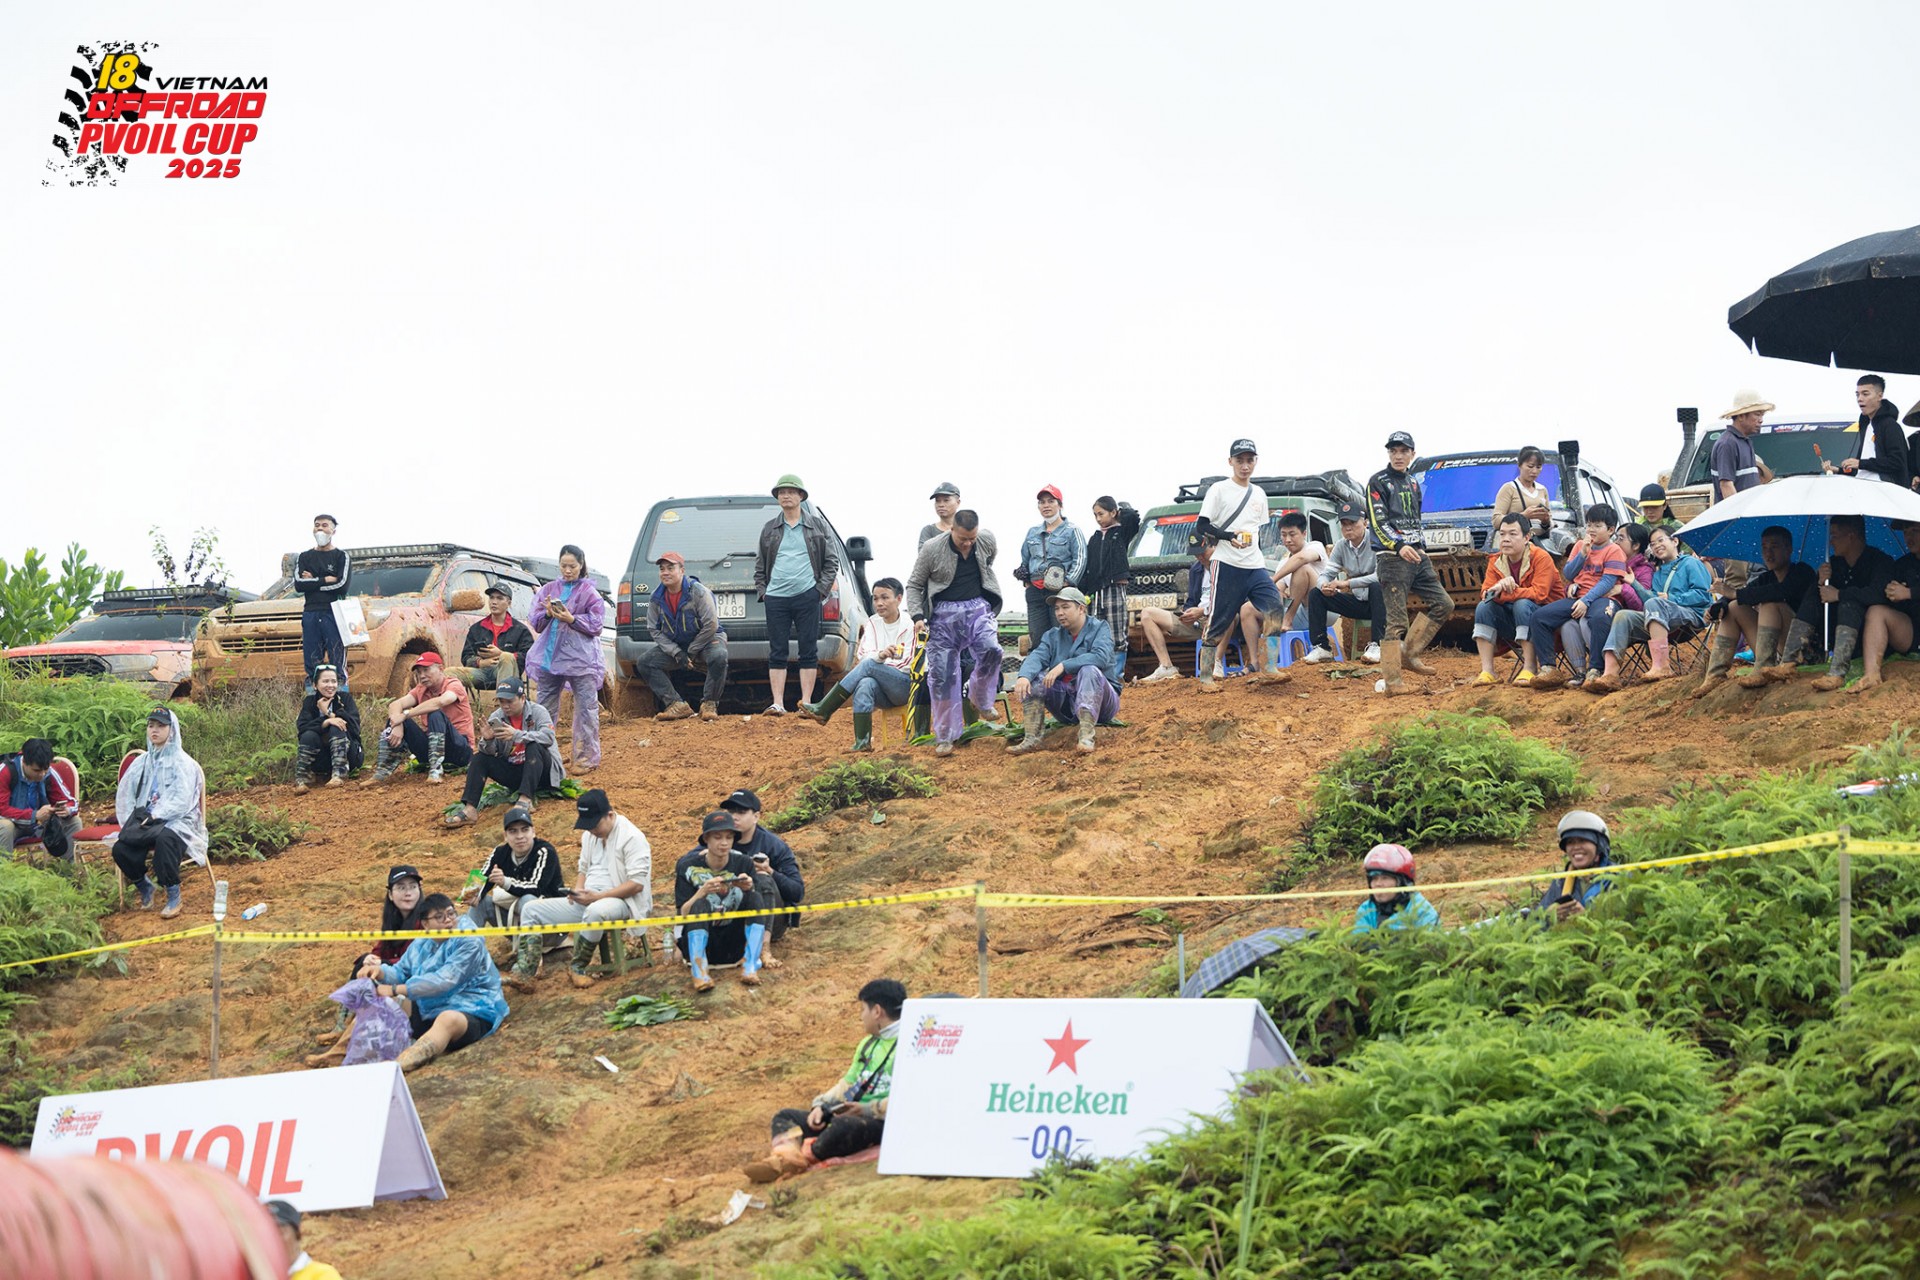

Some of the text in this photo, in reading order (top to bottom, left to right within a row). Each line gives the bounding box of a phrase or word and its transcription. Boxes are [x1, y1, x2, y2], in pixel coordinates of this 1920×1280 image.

[1443, 456, 1518, 466] PERFORMA
[1135, 574, 1176, 585] TOYOT
[717, 594, 737, 605] 81A
[986, 1083, 1128, 1115] Heineken
